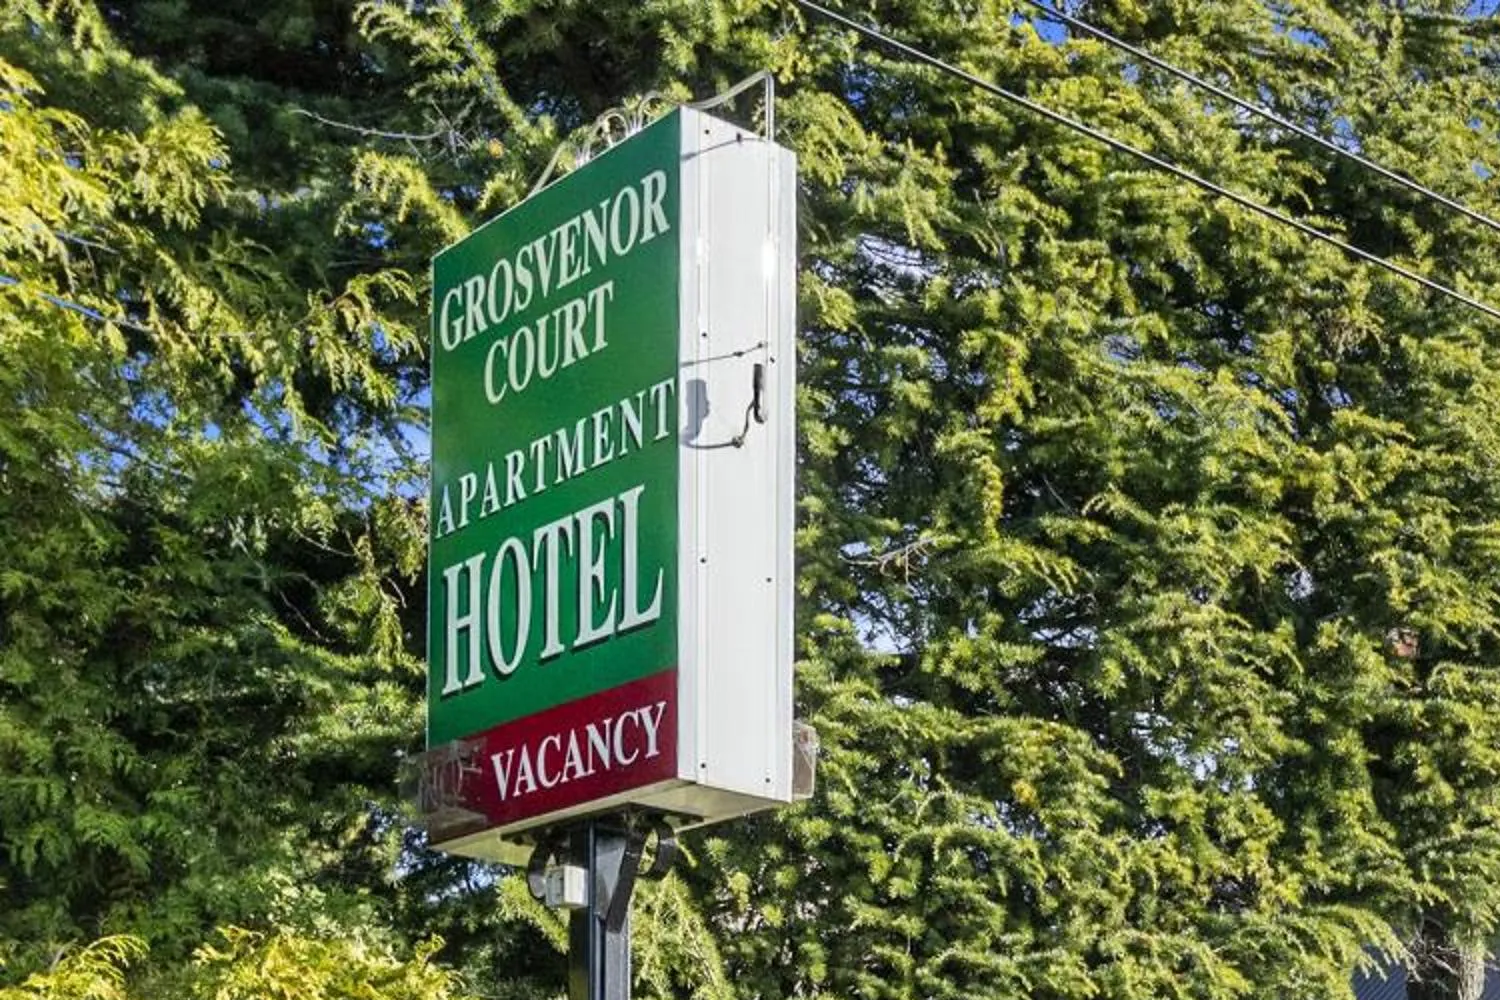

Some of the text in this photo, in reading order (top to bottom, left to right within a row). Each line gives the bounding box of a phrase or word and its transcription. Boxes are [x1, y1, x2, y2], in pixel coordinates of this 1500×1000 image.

[440, 170, 670, 352] GROSVENOR
[484, 281, 614, 405] COURT
[436, 378, 677, 540] APARTMENT
[441, 484, 664, 696] HOTEL
[491, 702, 667, 801] VACANCY
